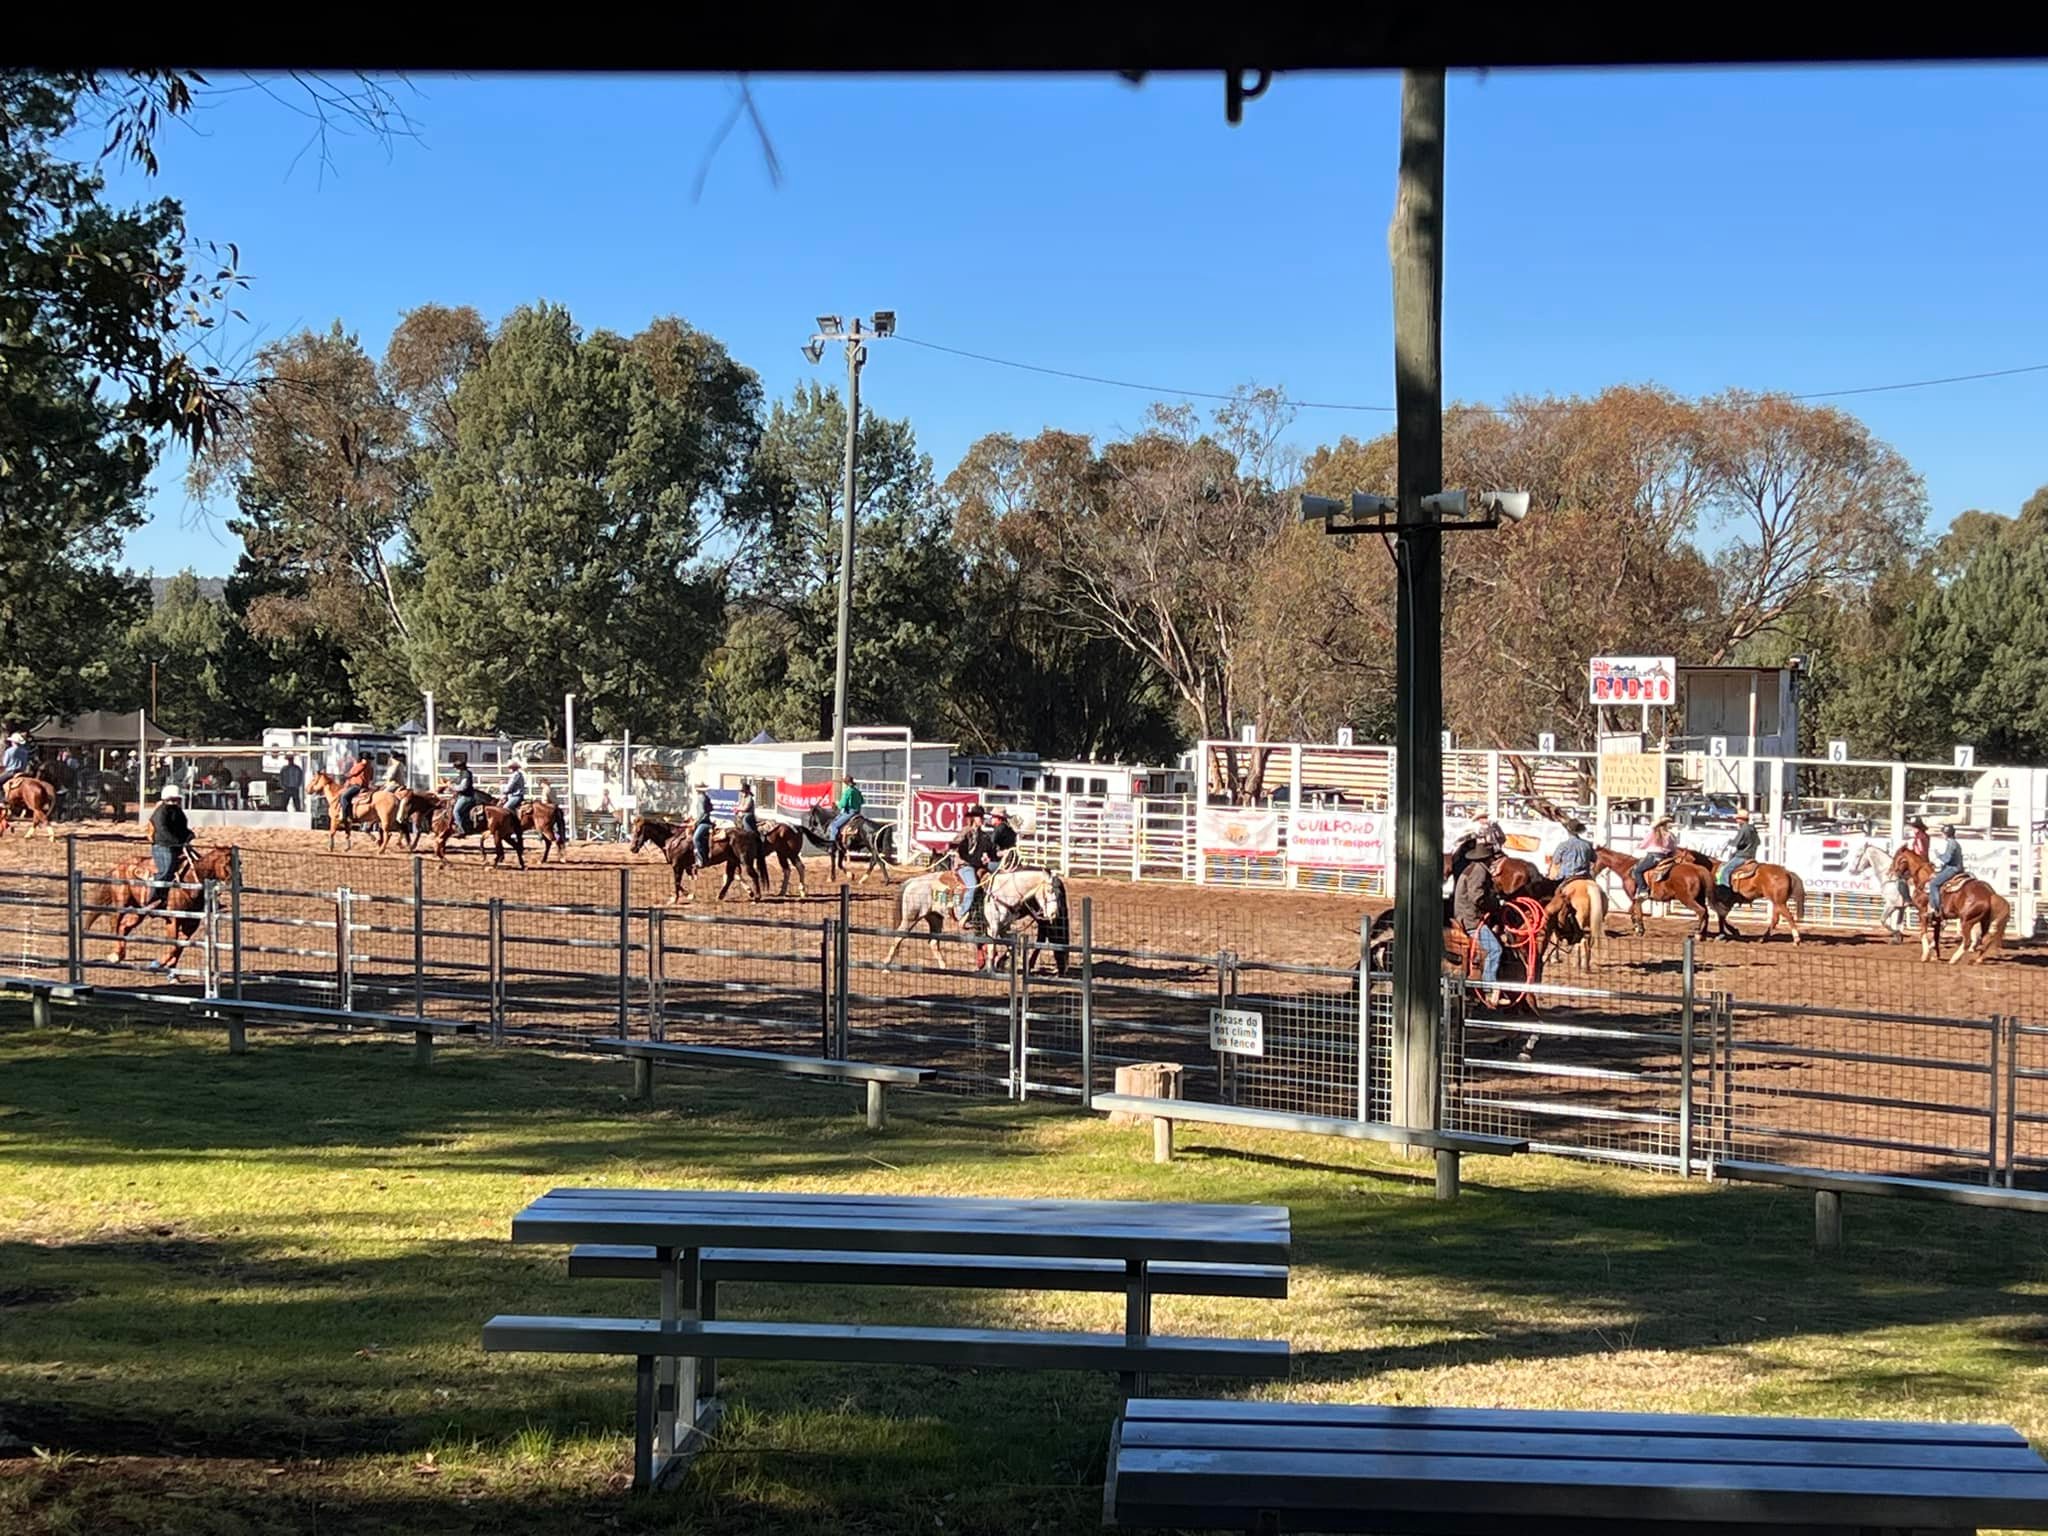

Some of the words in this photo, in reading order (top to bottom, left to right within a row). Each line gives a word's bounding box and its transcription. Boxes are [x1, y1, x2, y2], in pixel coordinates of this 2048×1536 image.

[1597, 678, 1669, 700] RODEO
[1342, 731, 1349, 746] 2
[1542, 736, 1551, 752] 4
[1714, 740, 1722, 757] 5
[1833, 744, 1842, 762] 6
[1960, 749, 1969, 767] 7
[1297, 819, 1374, 834] GUILFORD
[1292, 835, 1329, 847] General
[1332, 836, 1382, 849] Transport
[1804, 878, 1839, 889] OOTS
[1841, 879, 1873, 891] CIVIL
[1214, 1012, 1243, 1025] Please
[1246, 1016, 1258, 1026] do
[1231, 1027, 1257, 1039] climb
[1230, 1038, 1256, 1049] fence
